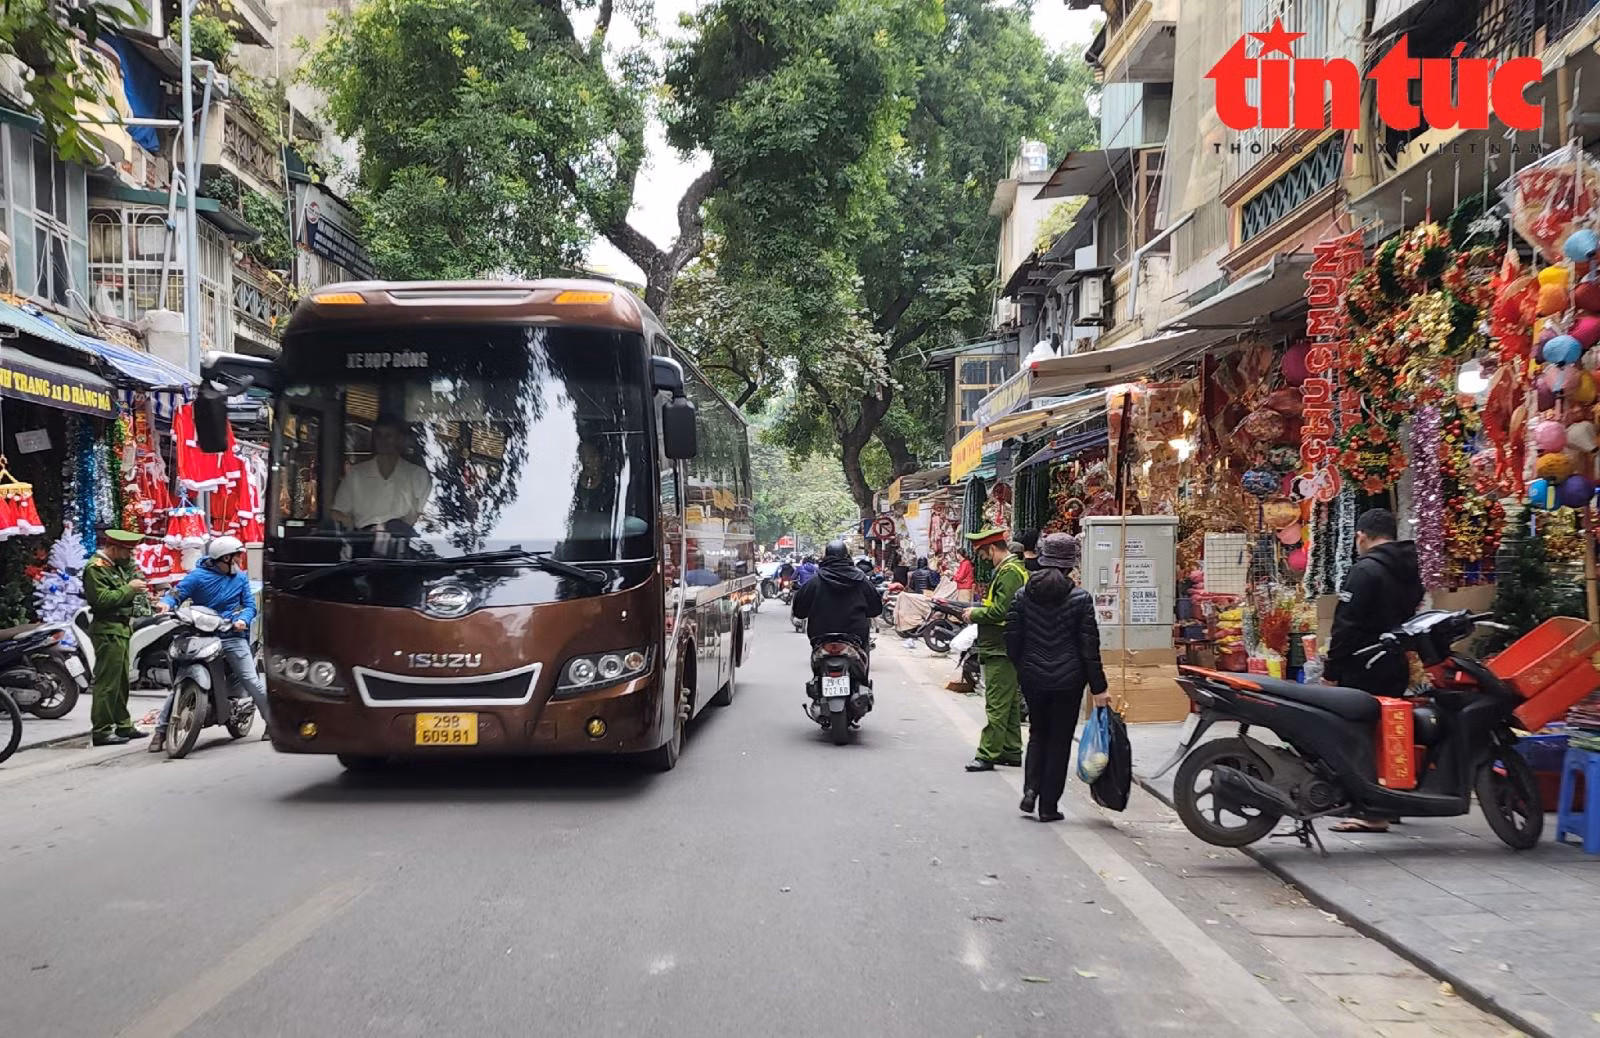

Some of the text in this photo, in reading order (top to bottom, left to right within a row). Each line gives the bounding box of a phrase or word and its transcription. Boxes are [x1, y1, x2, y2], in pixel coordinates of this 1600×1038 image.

[13, 372, 51, 397] TRANG
[62, 384, 71, 402] B
[72, 383, 97, 407] HÀNG
[408, 653, 482, 668] ISUZU
[422, 730, 470, 743] 609.81
